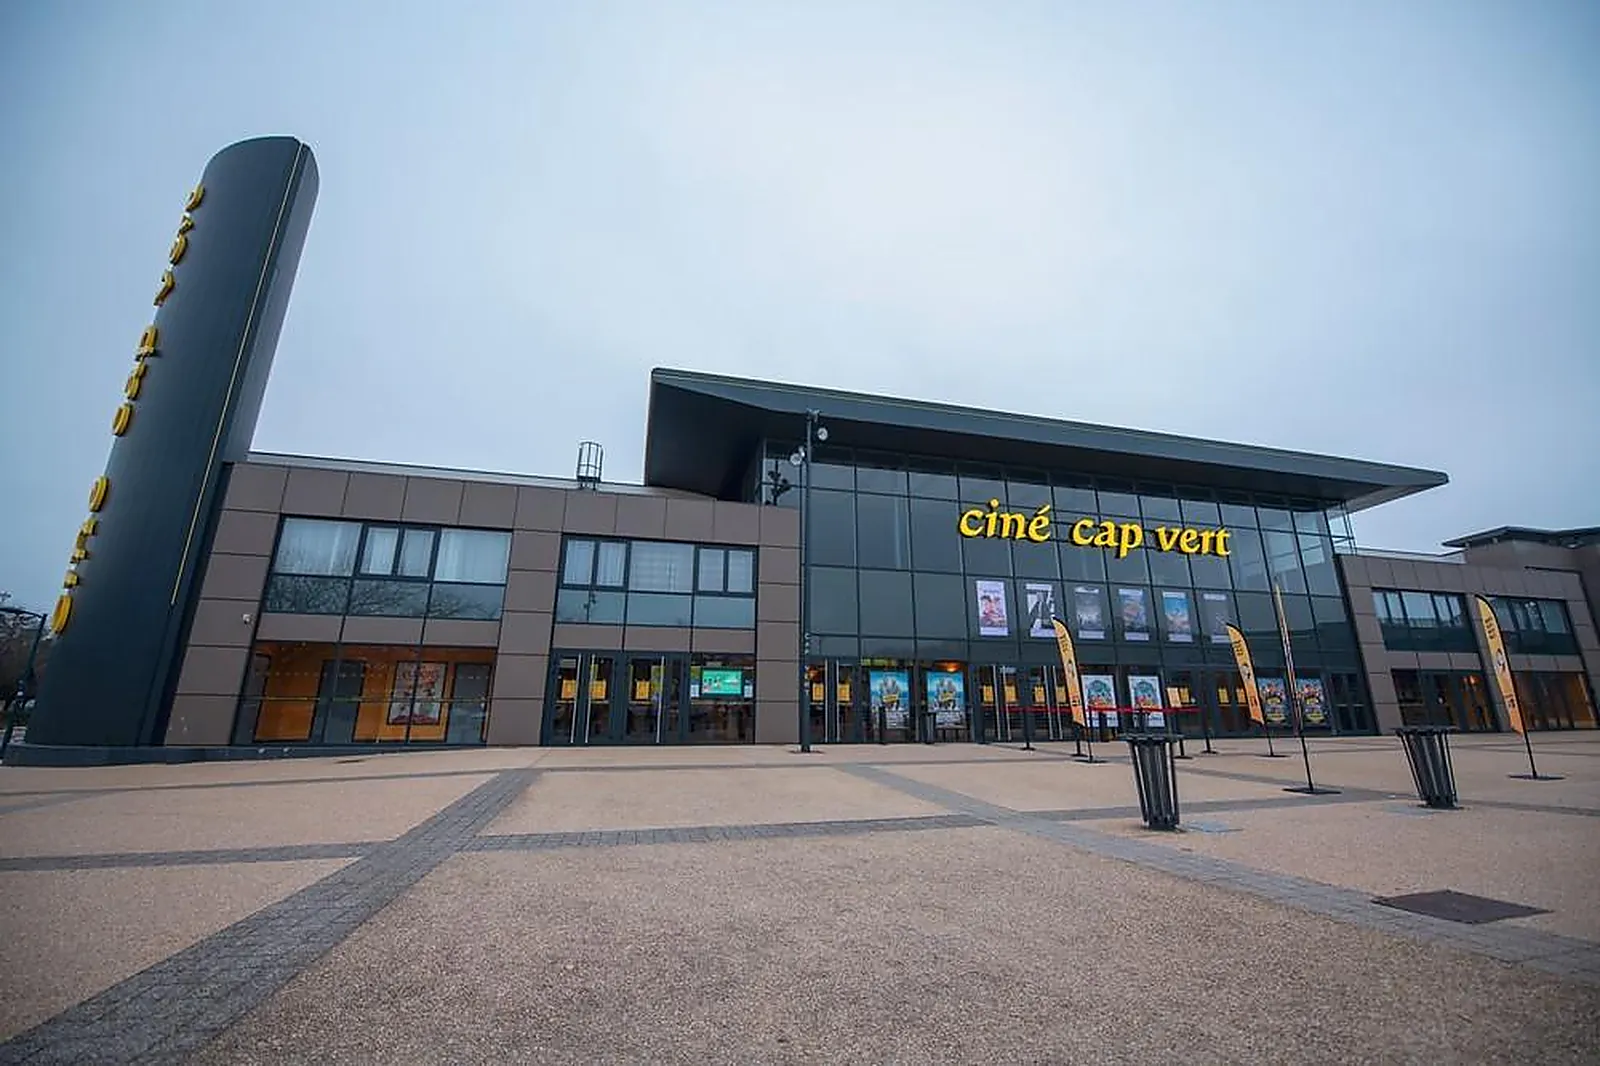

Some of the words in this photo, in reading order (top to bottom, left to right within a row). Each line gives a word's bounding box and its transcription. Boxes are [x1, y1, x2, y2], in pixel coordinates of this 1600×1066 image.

[959, 498, 1051, 542] ciné
[1071, 518, 1144, 558] cap
[1156, 524, 1231, 556] vert
